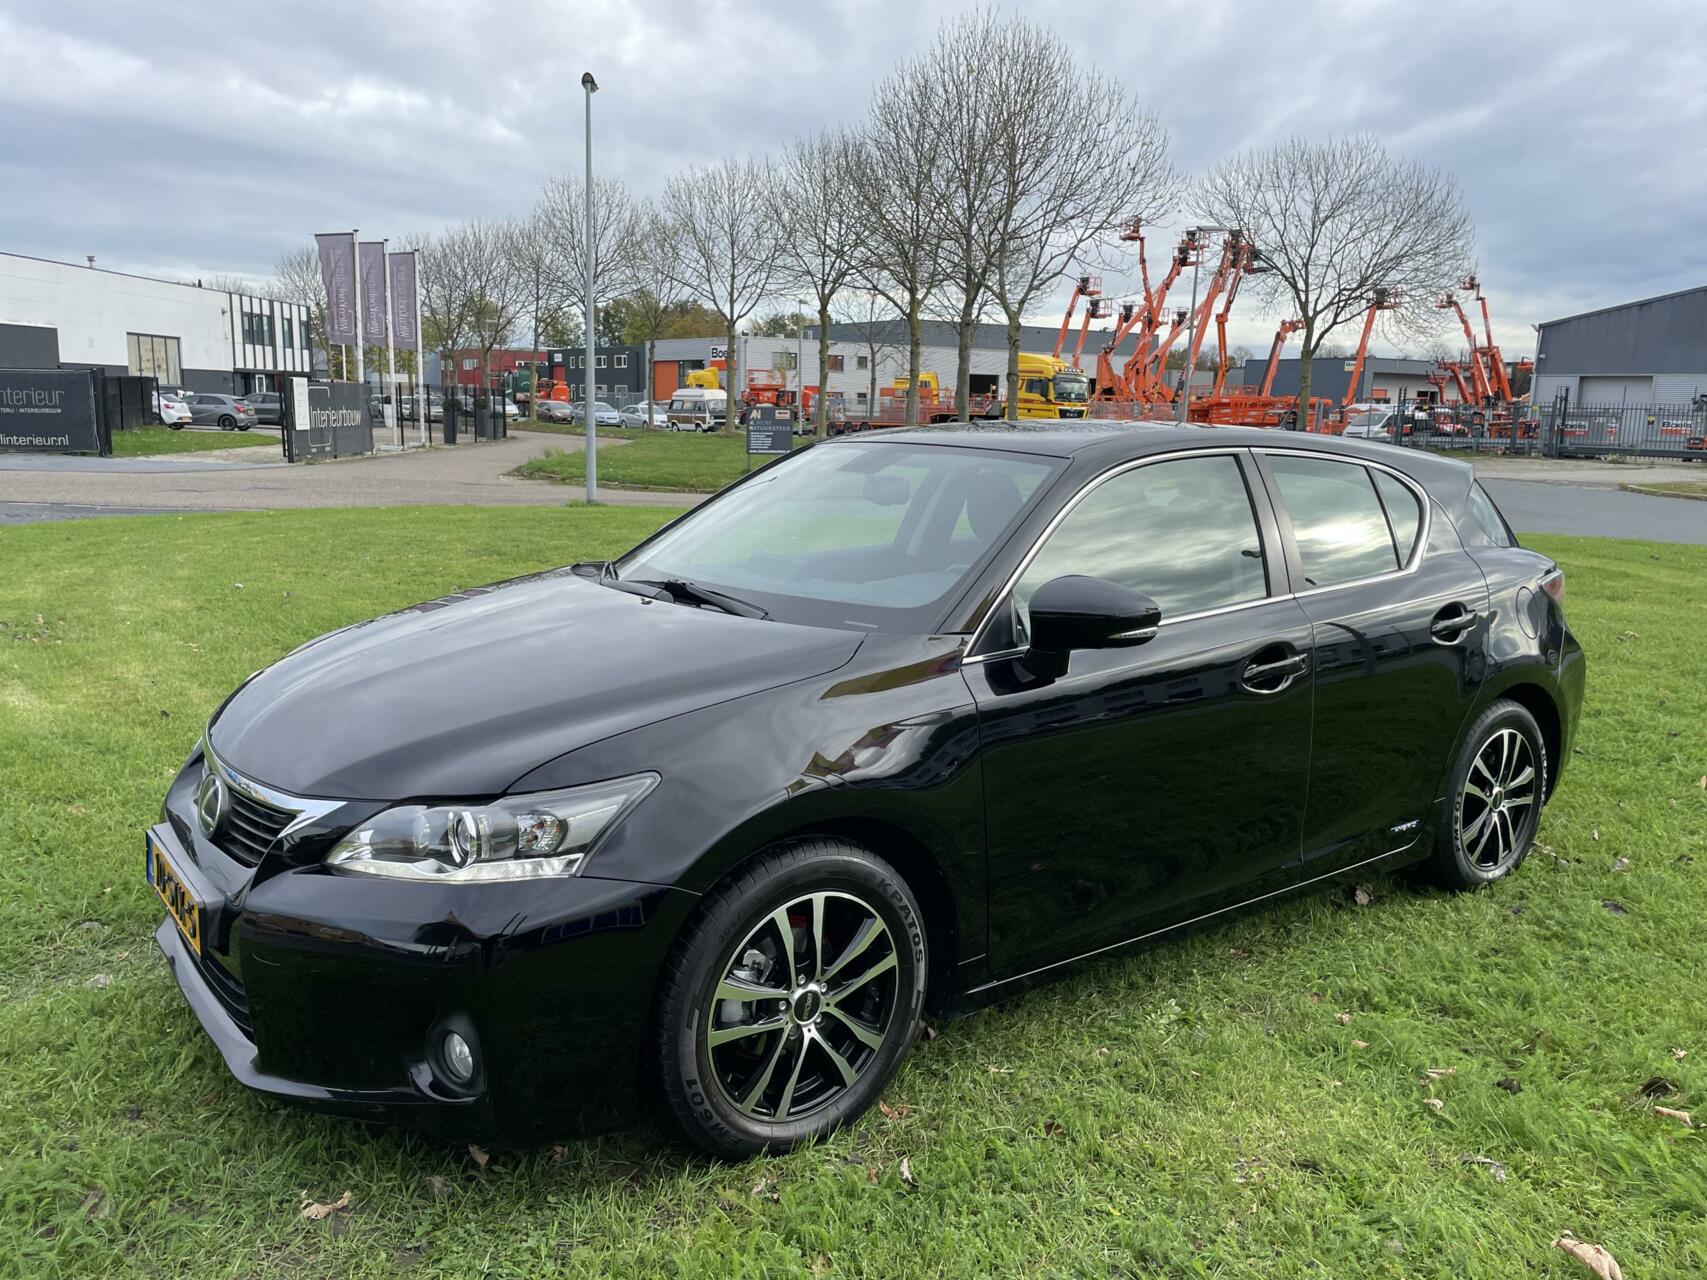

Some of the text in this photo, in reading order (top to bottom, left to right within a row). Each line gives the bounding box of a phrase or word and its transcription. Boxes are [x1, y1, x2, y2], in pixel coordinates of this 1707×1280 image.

[711, 347, 729, 358] Boe
[310, 404, 362, 429] Interieurbouw
[879, 878, 924, 964] KPATOS
